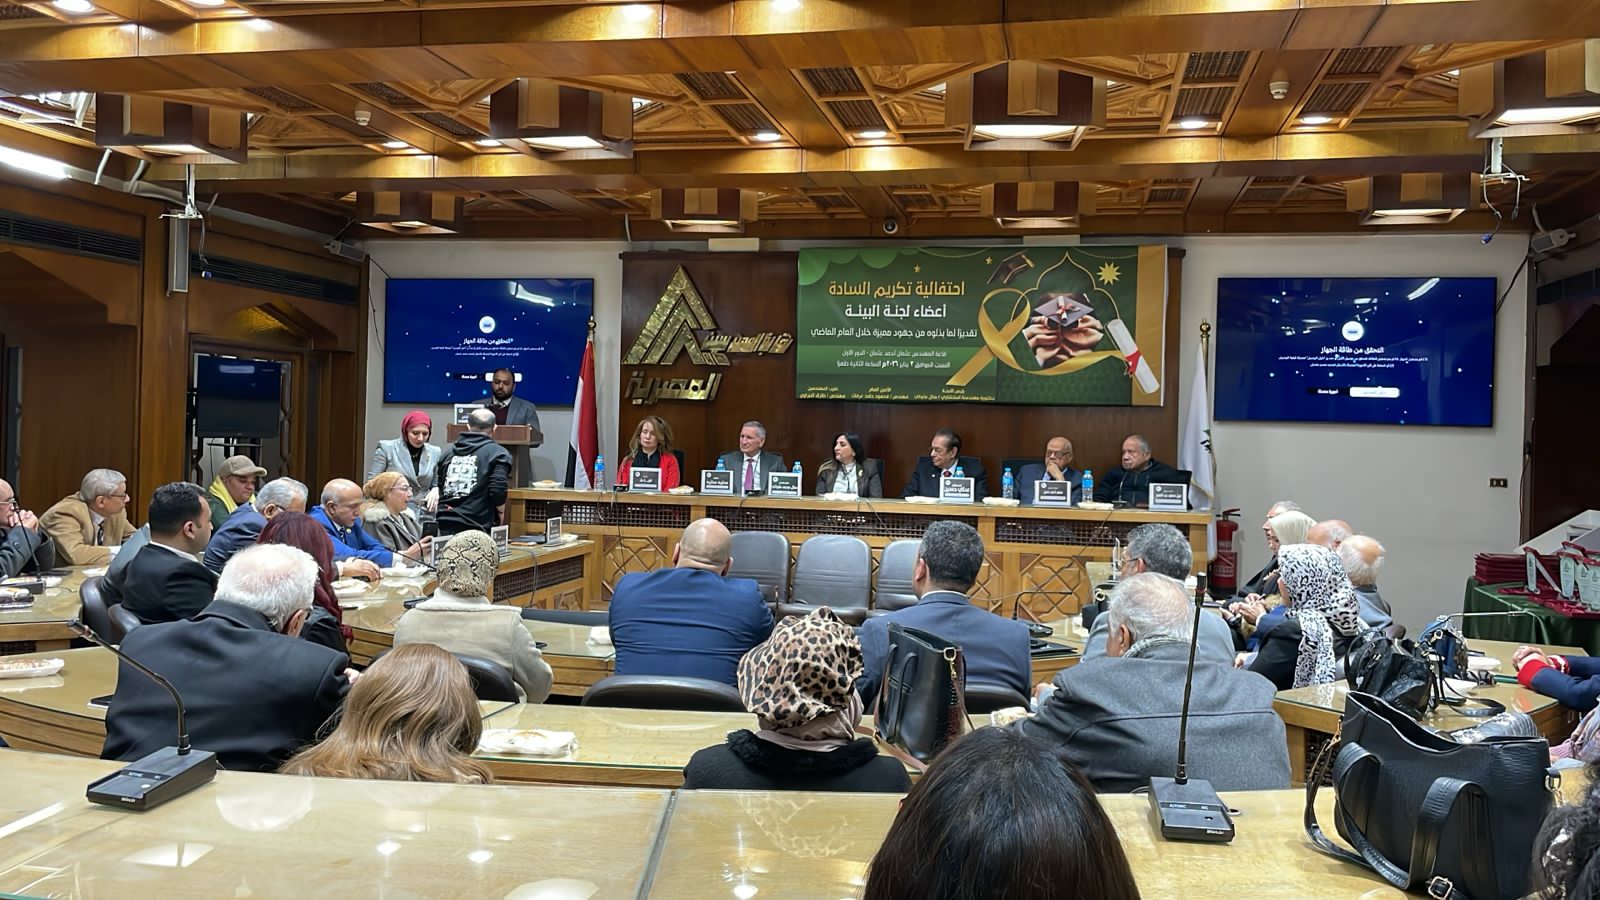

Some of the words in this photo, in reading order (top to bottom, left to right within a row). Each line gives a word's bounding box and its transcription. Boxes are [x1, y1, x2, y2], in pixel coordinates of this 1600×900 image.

[828, 280, 870, 296] السادة
[873, 280, 912, 299] تكريم
[915, 280, 965, 298] احتفالية
[845, 303, 880, 320] البيئة
[883, 303, 910, 318] لجنة
[913, 303, 947, 318] أعضاء
[810, 328, 837, 338] الماضي
[837, 327, 854, 338] العام
[855, 327, 871, 338] خلال
[872, 328, 892, 337] مميزة
[893, 328, 914, 338] جهود
[915, 329, 926, 338] من
[926, 328, 945, 338] بذلوه
[946, 328, 956, 337] لما
